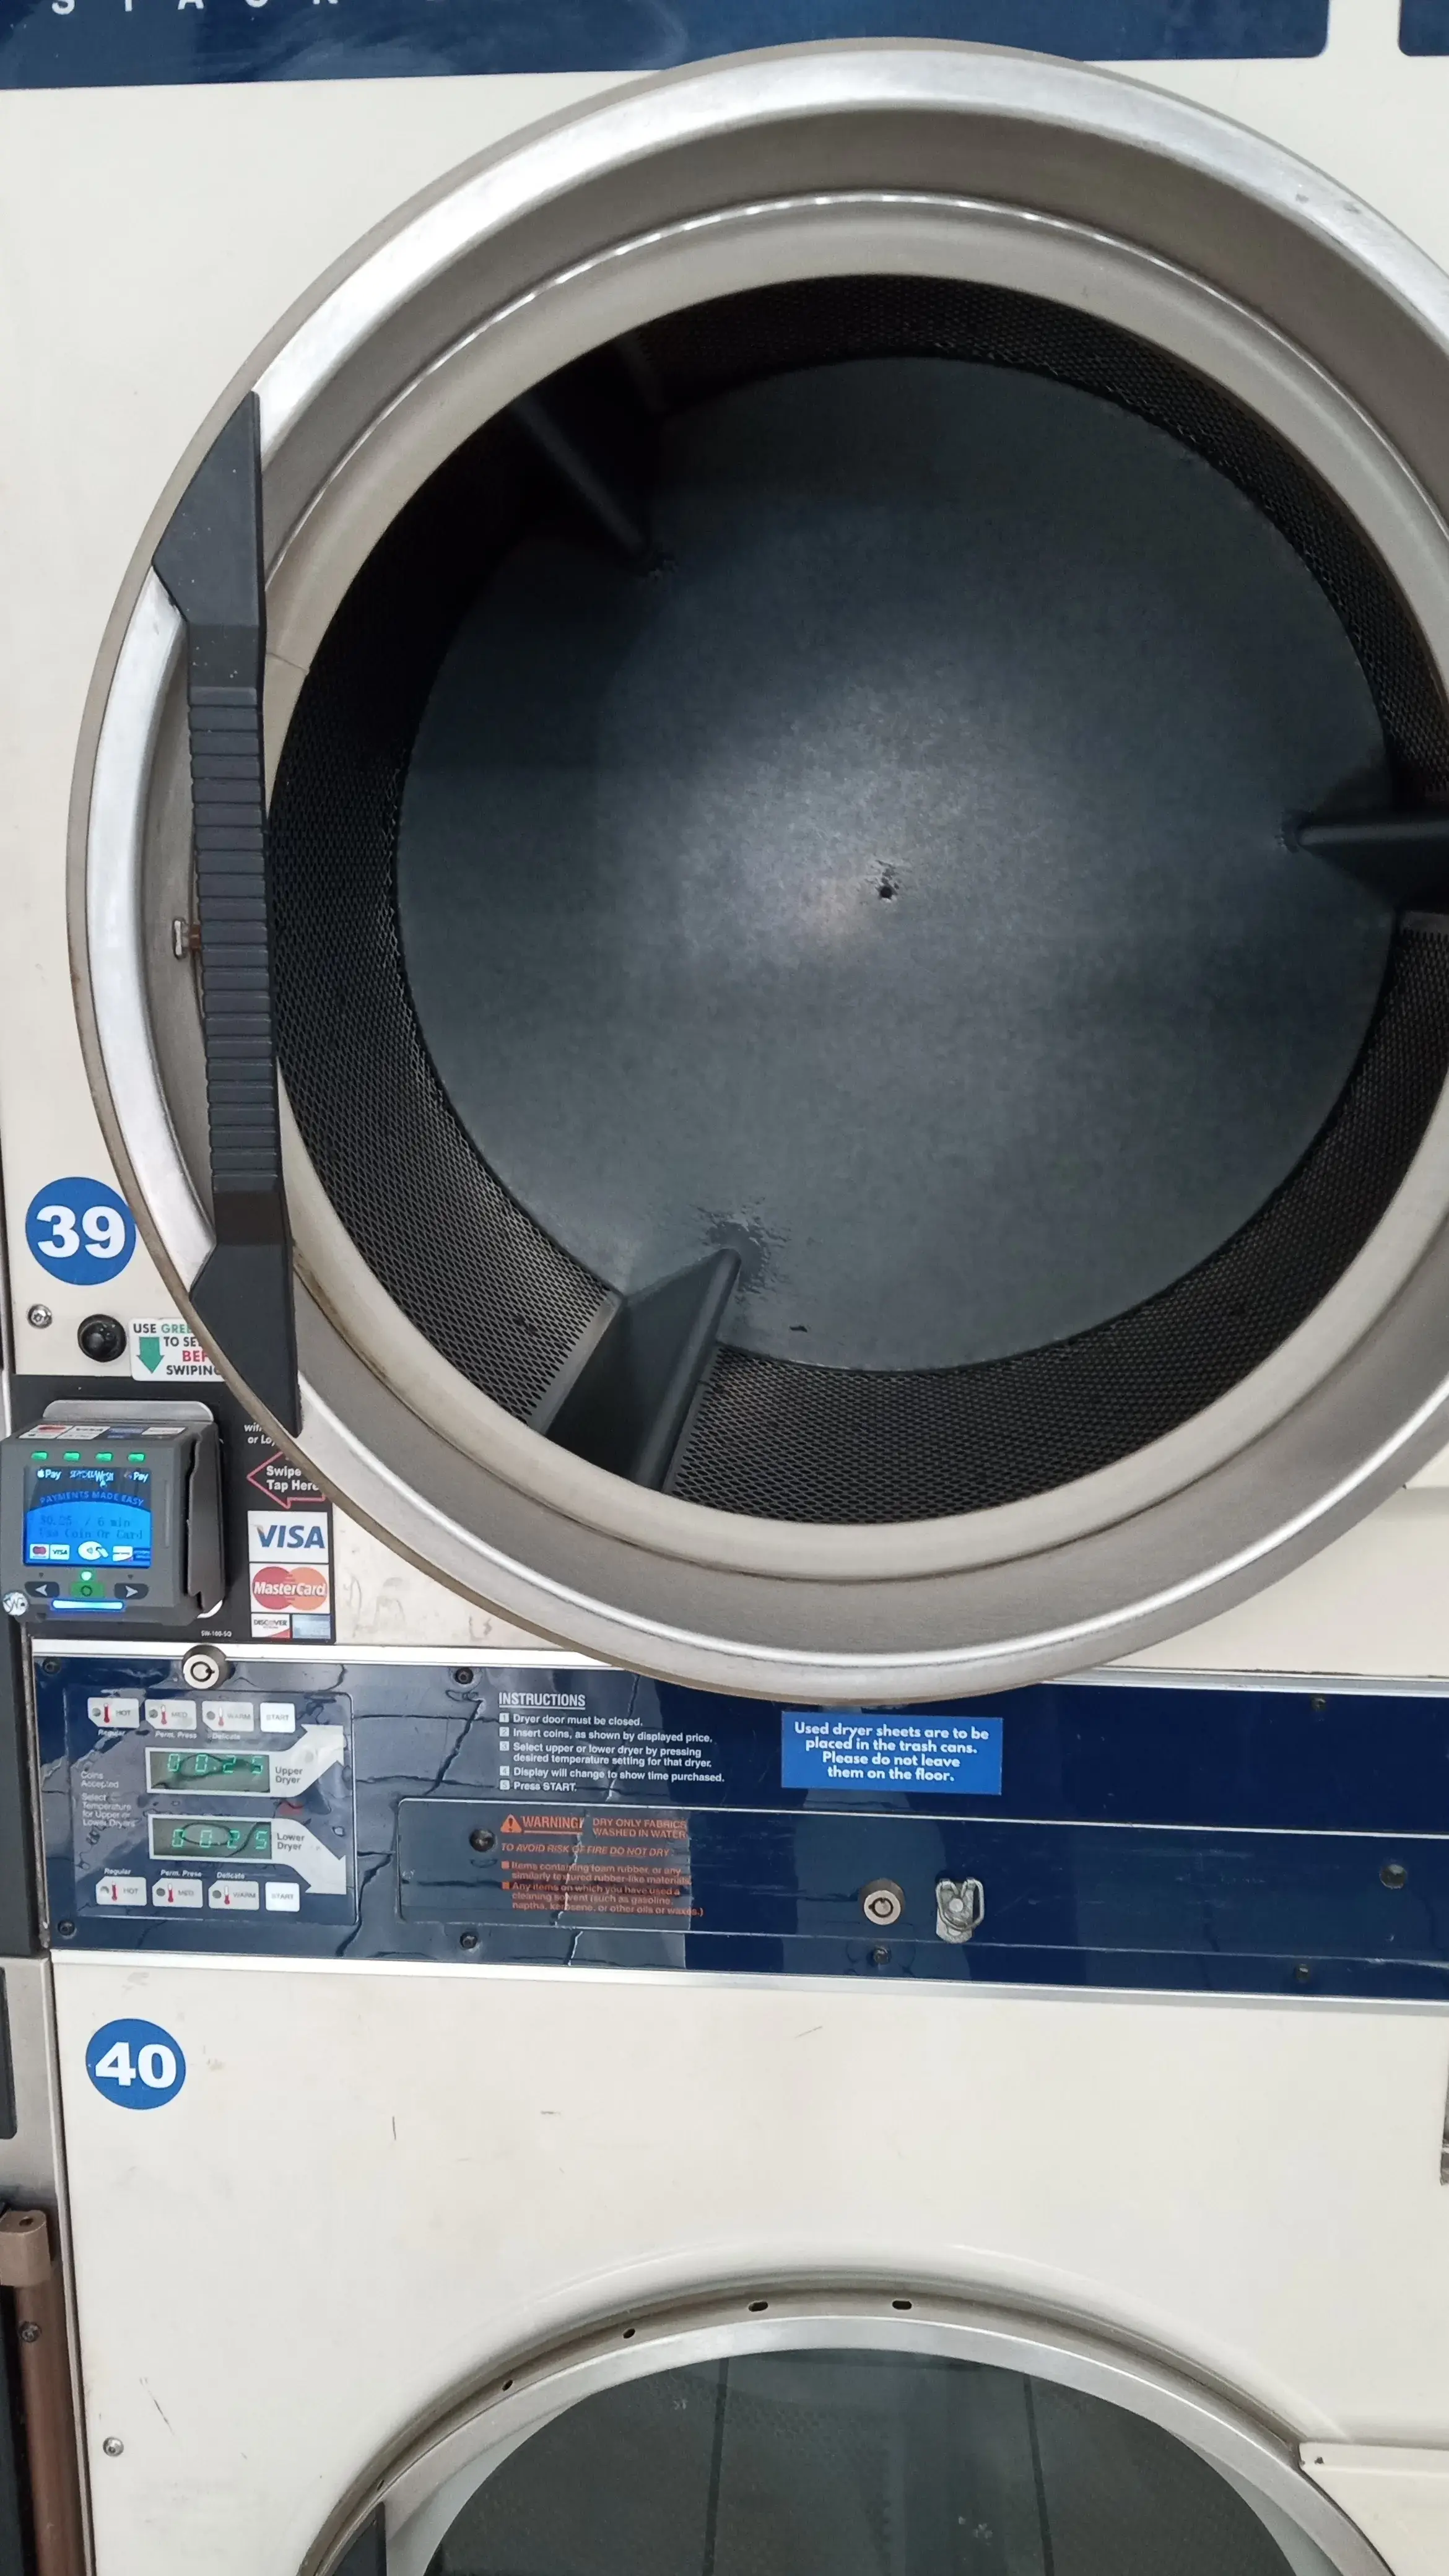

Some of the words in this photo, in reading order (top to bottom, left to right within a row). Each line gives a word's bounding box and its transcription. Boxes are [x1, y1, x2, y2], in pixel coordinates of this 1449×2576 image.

[37, 1204, 126, 1258] 39
[133, 1323, 157, 1333] USE
[163, 1336, 179, 1347] TO
[183, 1336, 200, 1347] SE
[248, 1435, 258, 1444] or
[45, 1469, 61, 1480] Pay
[133, 1472, 149, 1482] Pay
[266, 1465, 302, 1479] Swipe
[266, 1479, 289, 1493] Tap
[40, 1491, 89, 1505] PAYMENTS
[92, 1491, 118, 1502] MADE
[121, 1494, 144, 1506] EASY
[255, 1525, 326, 1549] VISA
[254, 1582, 326, 1596] MasterCard
[498, 1692, 586, 1707] INSTRUCTIONS
[513, 1713, 541, 1724] Dryer
[542, 1715, 564, 1724] door
[567, 1716, 591, 1725] must
[593, 1717, 606, 1725] be
[608, 1717, 643, 1726] closed.
[98, 1729, 126, 1737] Regular
[513, 1728, 541, 1738] Insert
[542, 1730, 572, 1739] coins,
[575, 1731, 586, 1739] as
[588, 1730, 620, 1739] shown
[622, 1731, 635, 1742] by
[637, 1732, 683, 1743] displayed
[794, 1721, 829, 1734] Used
[832, 1722, 873, 1738] dryer
[876, 1723, 921, 1738] sheets
[924, 1728, 949, 1738] are
[952, 1728, 968, 1739] to
[971, 1726, 990, 1739] be
[513, 1742, 543, 1752] Select
[546, 1744, 574, 1754] upper
[589, 1744, 616, 1753] lower
[617, 1745, 643, 1756] dryer
[645, 1746, 658, 1757] by
[659, 1747, 702, 1758] pressing
[806, 1736, 853, 1752] placed
[856, 1738, 869, 1750] in
[873, 1738, 896, 1751] the
[899, 1739, 937, 1752] trash
[940, 1744, 978, 1754] cans.
[513, 1753, 549, 1762] desired
[551, 1754, 609, 1765] temperature
[612, 1757, 645, 1767] setting
[647, 1757, 661, 1766] for
[663, 1757, 682, 1767] that
[822, 1751, 869, 1764] Please
[871, 1752, 891, 1765] do
[894, 1754, 918, 1766] not
[921, 1753, 960, 1767] leave
[275, 1766, 303, 1777] Upper
[513, 1767, 549, 1778] Display
[551, 1768, 567, 1777] will
[569, 1769, 605, 1780] change
[607, 1770, 617, 1778] to
[619, 1770, 645, 1780] show
[648, 1771, 669, 1780] time
[671, 1773, 724, 1783] purchased.
[827, 1764, 864, 1778] them
[867, 1770, 886, 1779] on
[889, 1767, 912, 1780] the
[915, 1767, 955, 1782] floor.
[275, 1775, 300, 1785] Dryer
[513, 1782, 541, 1791] Press
[593, 1818, 615, 1827] DRY
[616, 1819, 642, 1827] ONLY
[643, 1819, 687, 1829] FABRICS
[277, 1832, 305, 1842] Lower
[593, 1828, 637, 1837] WASHED
[638, 1829, 649, 1838] IN
[651, 1830, 686, 1839] WATER
[277, 1842, 302, 1852] Dryer
[502, 1842, 514, 1852] TO
[516, 1843, 546, 1852] AVOID
[547, 1845, 570, 1853] RISK
[587, 1845, 608, 1855] FIRE
[610, 1847, 625, 1855] DO
[627, 1847, 648, 1856] NOT
[104, 1868, 132, 1876] Regular
[511, 1861, 538, 1870] Items
[590, 1864, 615, 1873] foam
[217, 1871, 245, 1879] Delicate
[512, 1871, 550, 1881] similarly
[511, 1882, 531, 1891] Any
[533, 1883, 559, 1891] items
[575, 1884, 603, 1892] which
[649, 1887, 672, 1895] used
[609, 1904, 635, 1913] other
[94, 2042, 176, 2089] 40
